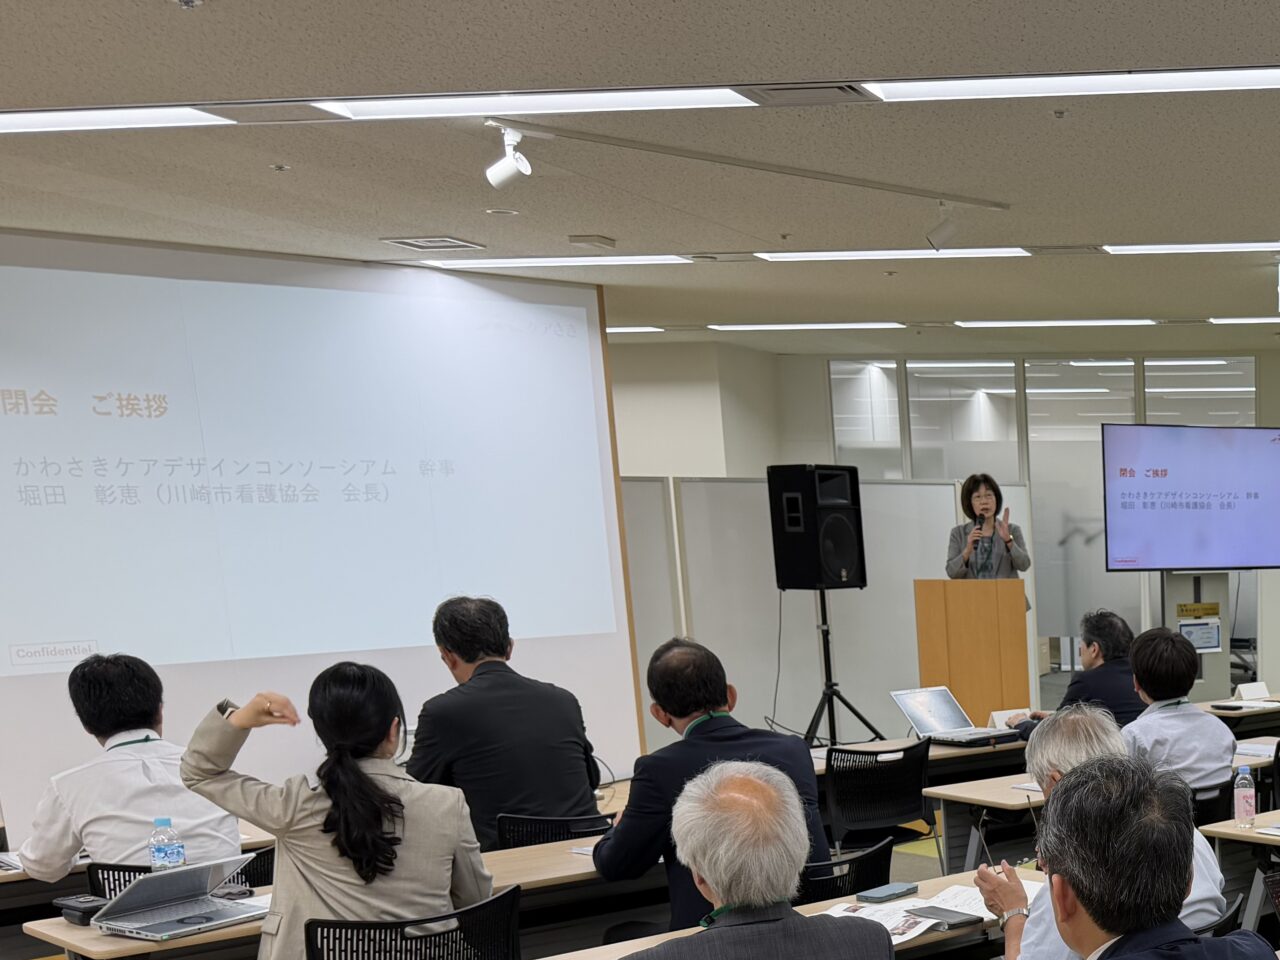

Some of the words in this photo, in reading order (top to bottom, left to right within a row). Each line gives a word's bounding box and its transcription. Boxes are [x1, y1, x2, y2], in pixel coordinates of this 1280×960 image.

[0, 389, 58, 416] 閉会
[91, 392, 169, 418] ご挨拶
[13, 455, 397, 478] かわさきケアデザインコンソーシアム
[17, 484, 67, 507] 堀田
